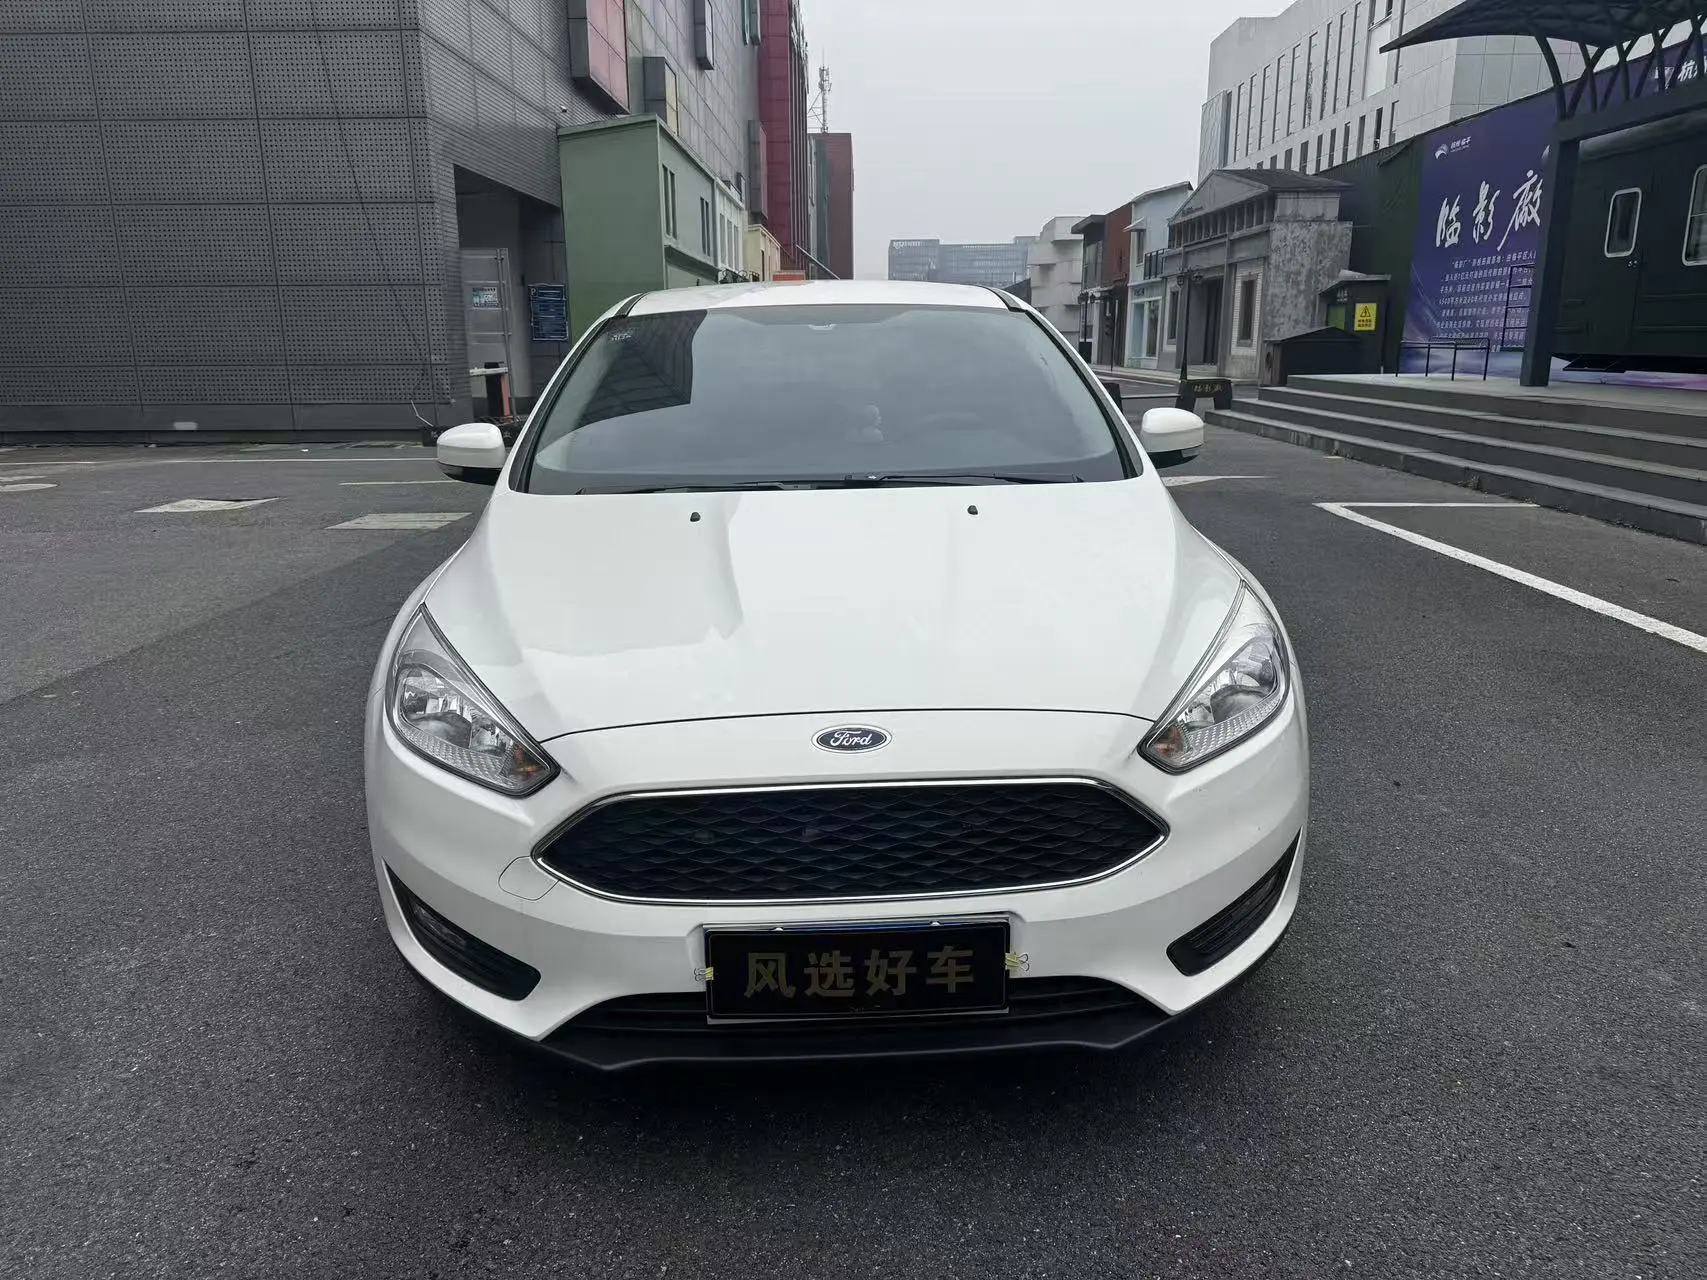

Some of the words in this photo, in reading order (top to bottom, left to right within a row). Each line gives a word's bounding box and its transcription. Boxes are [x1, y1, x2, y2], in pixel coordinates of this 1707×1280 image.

[830, 730, 873, 747] Ford
[744, 945, 975, 998] 风选好车
